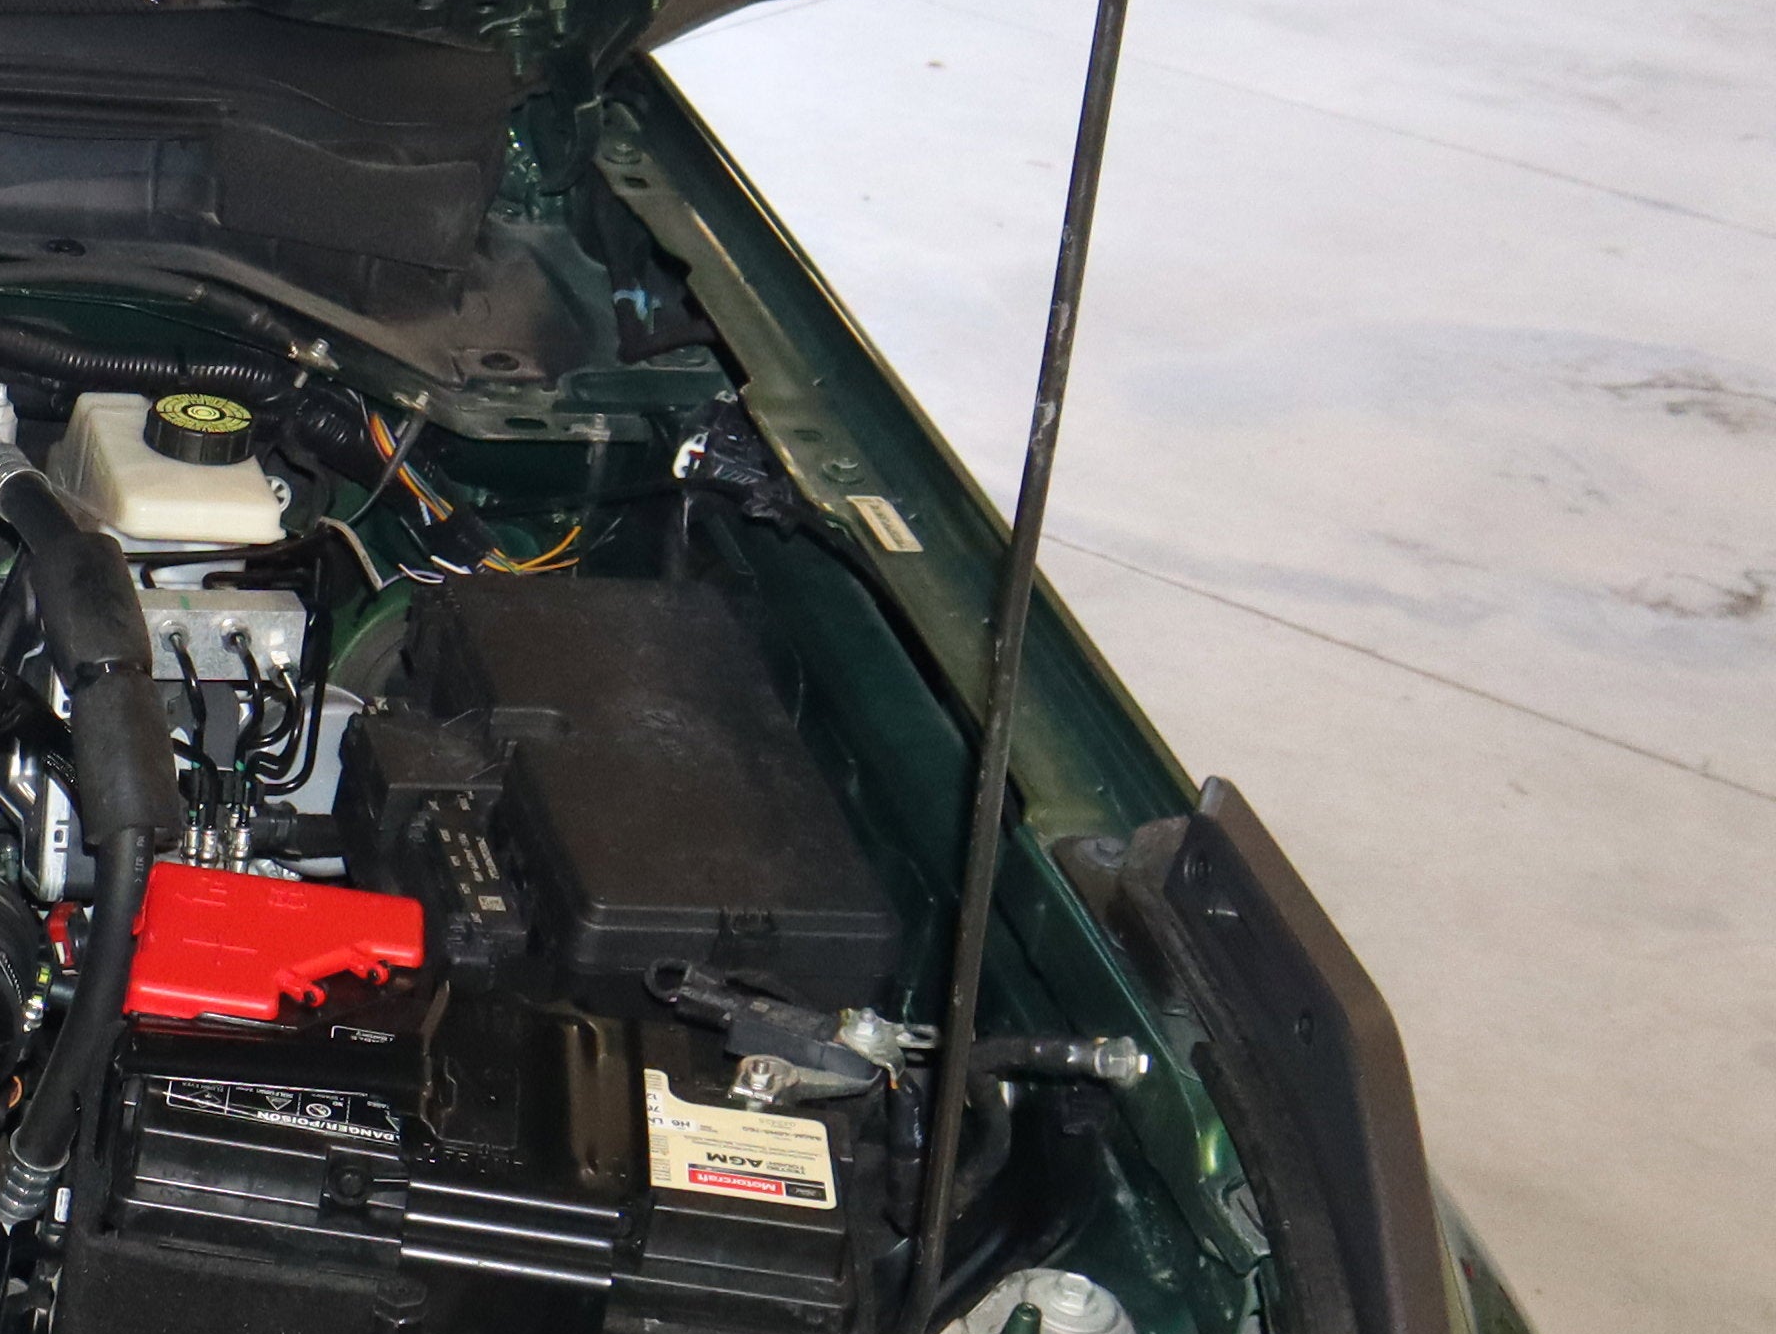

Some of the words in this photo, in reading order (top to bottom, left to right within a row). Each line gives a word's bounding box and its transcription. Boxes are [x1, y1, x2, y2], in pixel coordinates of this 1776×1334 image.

[256, 1110, 395, 1142] DANGER/POISON
[706, 1152, 764, 1168] AGM
[696, 1173, 777, 1192] Motorcraft
